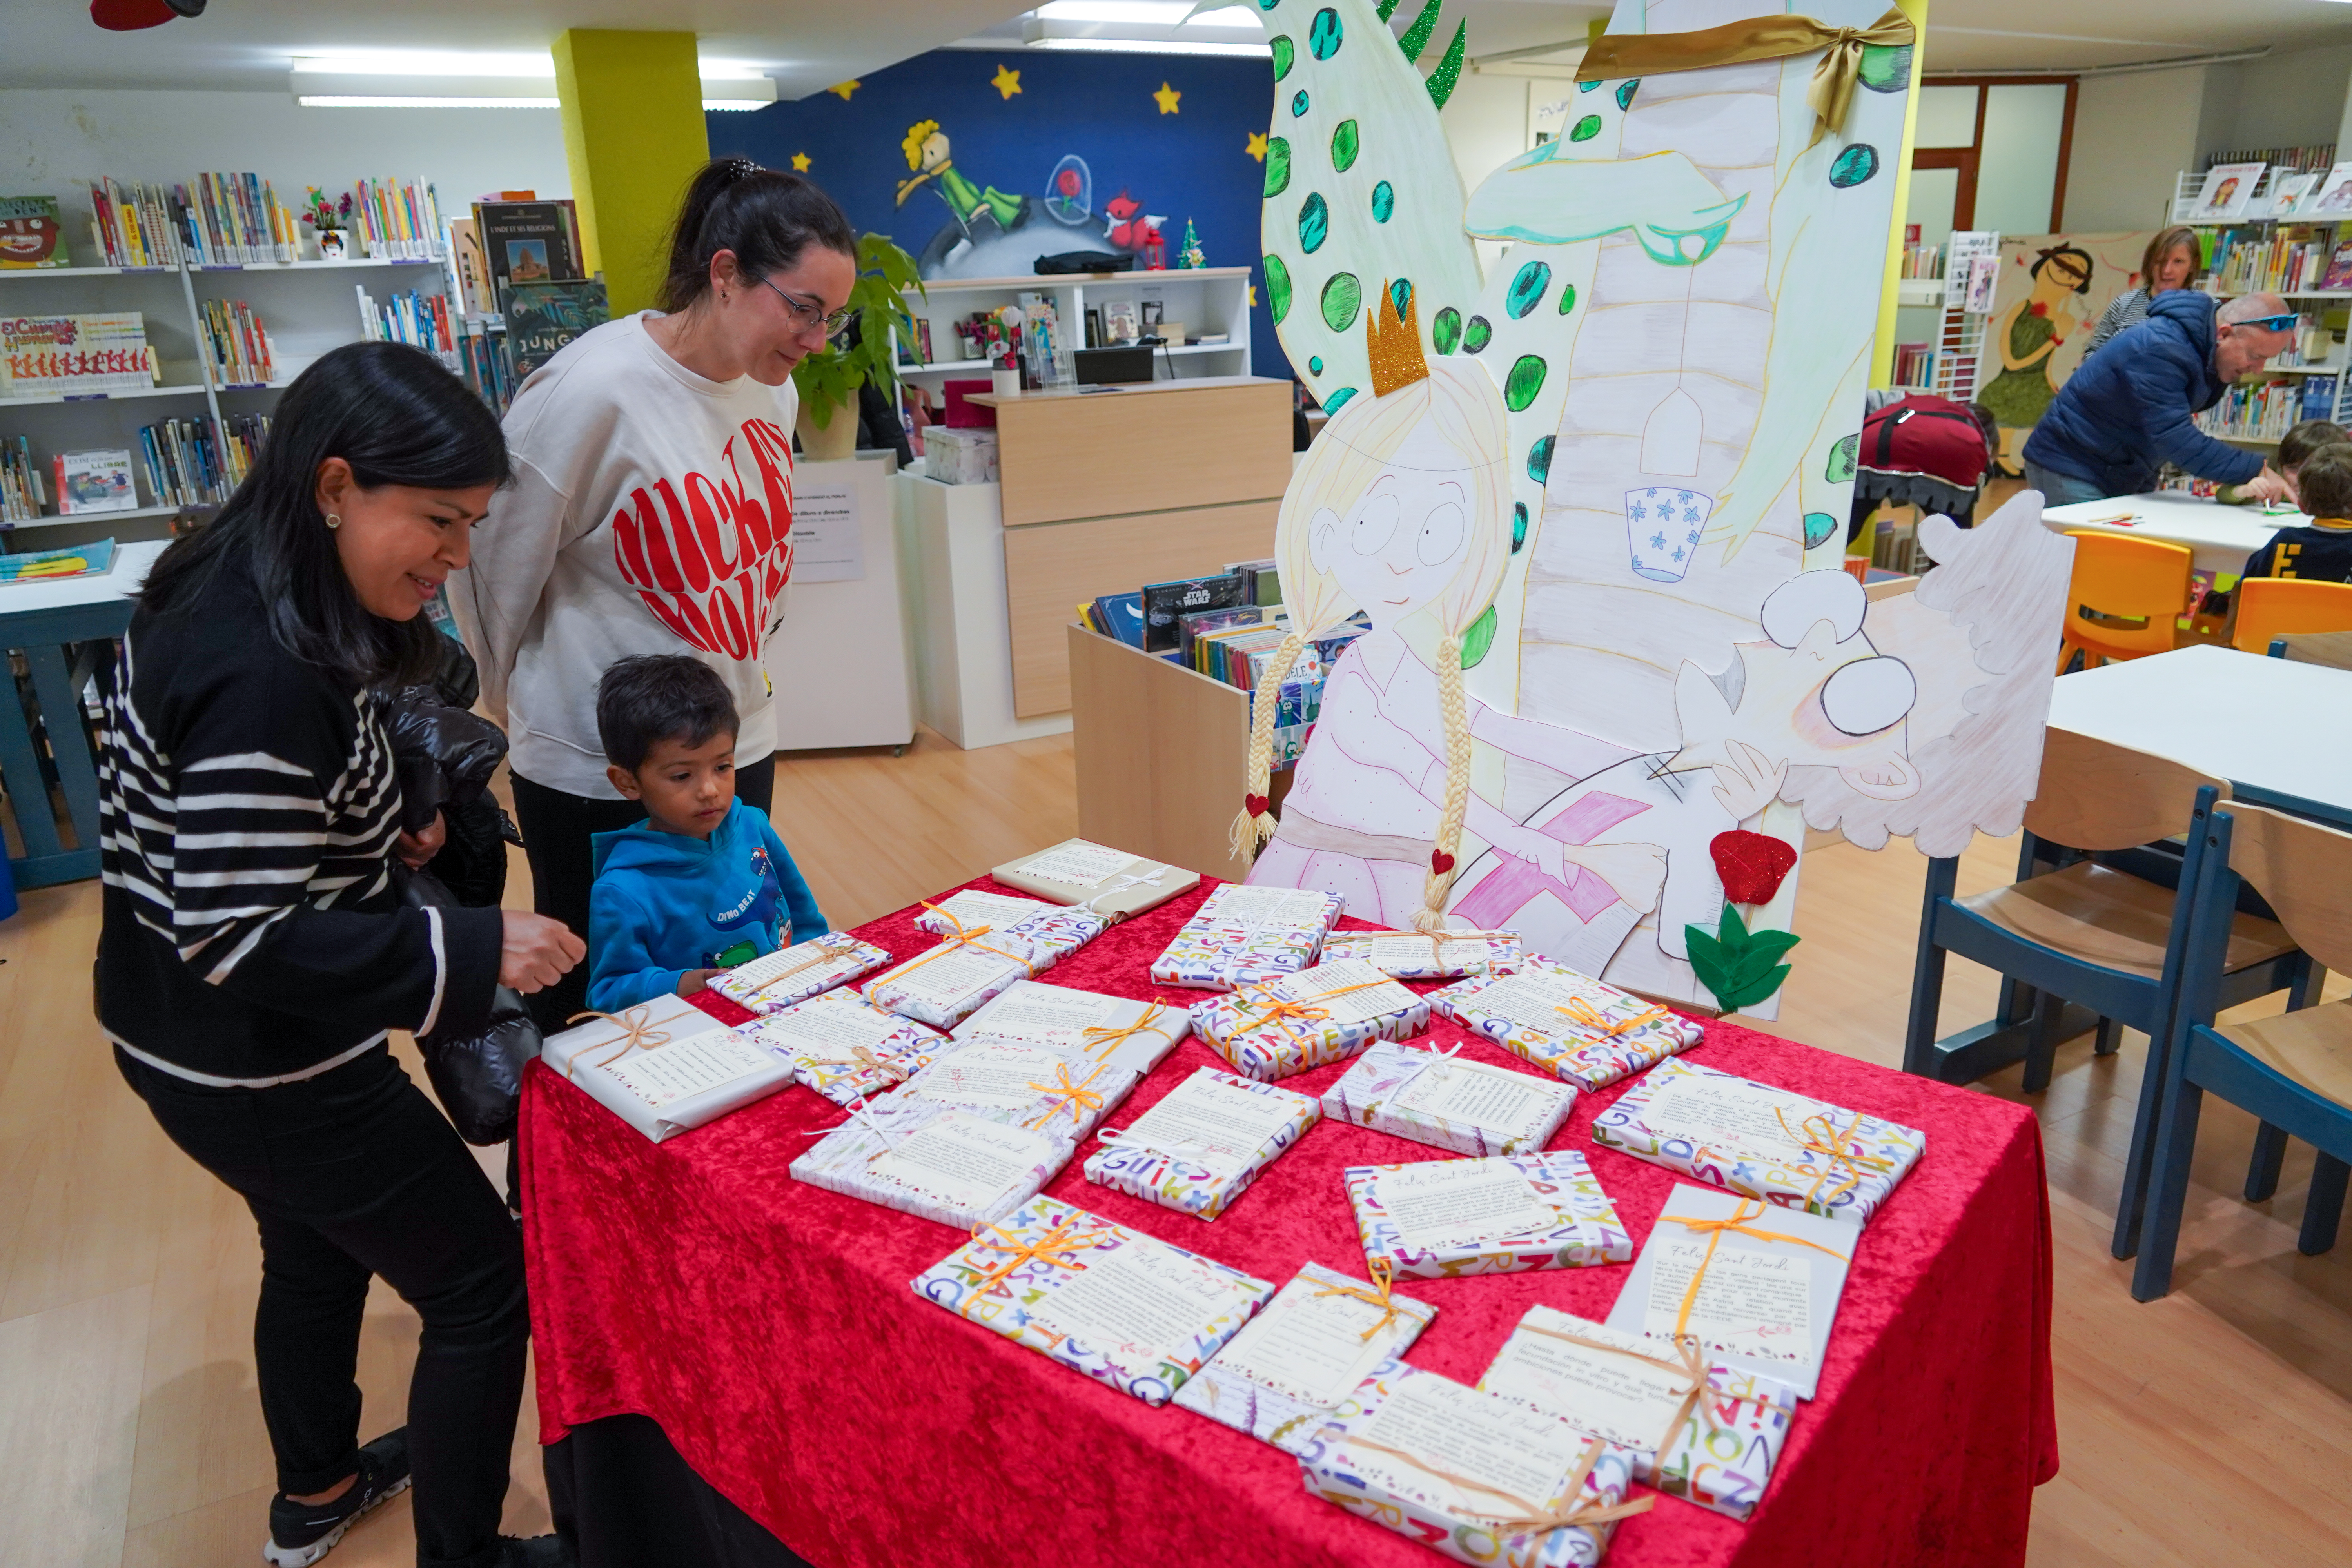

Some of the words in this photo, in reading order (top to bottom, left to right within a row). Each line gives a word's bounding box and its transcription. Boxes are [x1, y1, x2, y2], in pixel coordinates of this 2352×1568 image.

[519, 334, 577, 352] JUNG
[637, 540, 793, 660] MOUS
[1183, 590, 1210, 599] STAR
[1183, 596, 1211, 606] WARS
[1286, 666, 1308, 680] DELE
[717, 909, 739, 922] DINO
[738, 889, 755, 912] BEAT
[1549, 984, 1575, 993] Sant
[1573, 991, 1602, 1002] Jordi
[963, 1052, 987, 1060] Feliç
[1191, 1087, 1217, 1100] Feliç
[1218, 1096, 1249, 1107] Sant
[1246, 1103, 1280, 1116] Jordi
[1696, 1088, 1724, 1100] Feliç
[1728, 1096, 1759, 1105] Sant
[946, 1124, 971, 1137] Feliç
[971, 1134, 1000, 1145] Sant
[997, 1142, 1031, 1155] Jordi
[1393, 1174, 1425, 1189] Feliç
[1430, 1171, 1456, 1183] Sant
[1460, 1163, 1493, 1178] Jordi
[1671, 1246, 1707, 1263] Feliç
[1711, 1250, 1746, 1265] Sant
[1751, 1258, 1789, 1271] Jordi
[1131, 1251, 1161, 1272] Feliç
[1157, 1268, 1193, 1285] Sant
[1185, 1281, 1227, 1301] Jordi
[1683, 1264, 1710, 1273] Réseu,
[1752, 1276, 1786, 1284] partagent
[1653, 1282, 1683, 1290] intenses
[1700, 1308, 1757, 1321] immédiatement
[1759, 1318, 1792, 1327] emmené
[1733, 1308, 1768, 1316] renverser
[1518, 1348, 1571, 1370] fecundación
[1590, 1372, 1609, 1382] vitro
[1624, 1385, 1642, 1394] qué
[1647, 1392, 1679, 1406] turbias
[1522, 1343, 1555, 1355] ¿Hasta
[1563, 1355, 1592, 1367] dónde
[1600, 1367, 1630, 1380] puede
[1639, 1379, 1666, 1392] llegar
[1513, 1357, 1563, 1376] ambiciones
[1564, 1374, 1594, 1387] puede
[1595, 1384, 1644, 1403] provocar?
